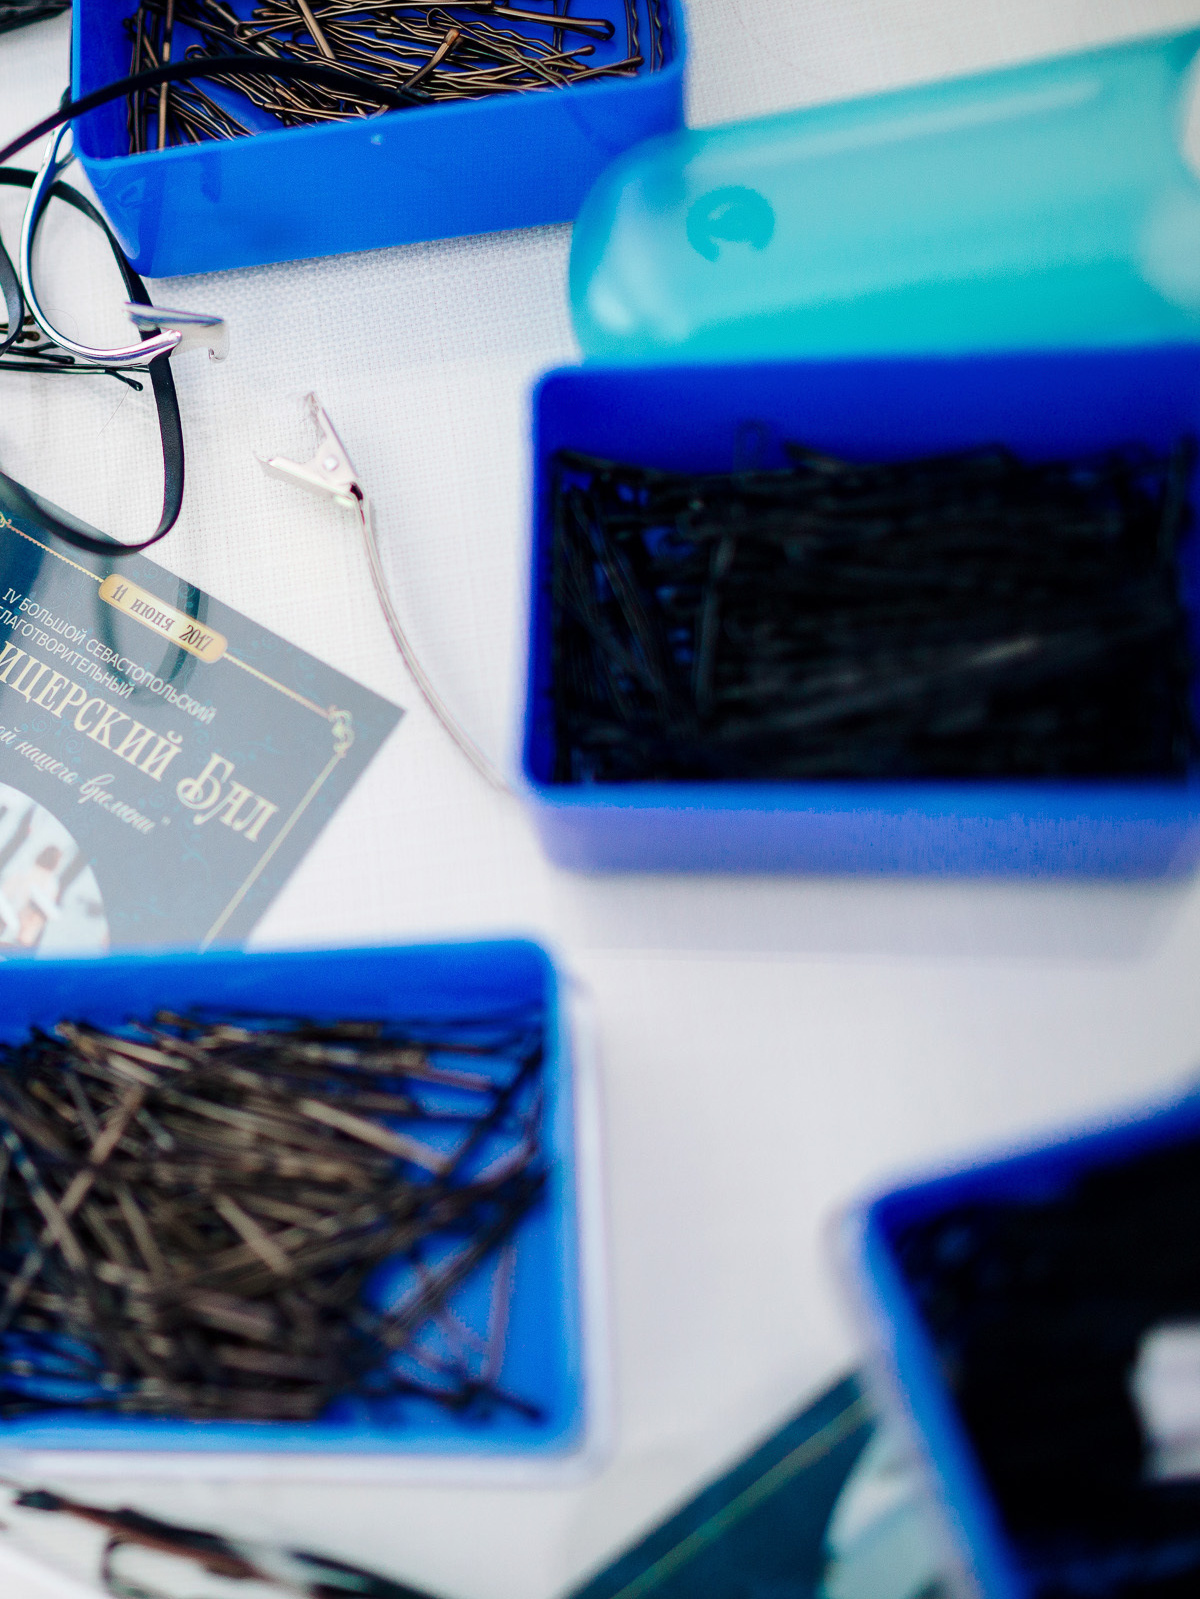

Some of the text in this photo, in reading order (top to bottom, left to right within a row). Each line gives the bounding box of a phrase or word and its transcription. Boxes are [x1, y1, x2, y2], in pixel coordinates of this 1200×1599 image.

[2, 587, 217, 725] IV БОЛЬШОЙ СЕВАСТОПОЛЬСКИЙ
[110, 584, 214, 652] 11 июня 2017
[14, 740, 80, 786] нашего
[77, 773, 172, 835] времени"
